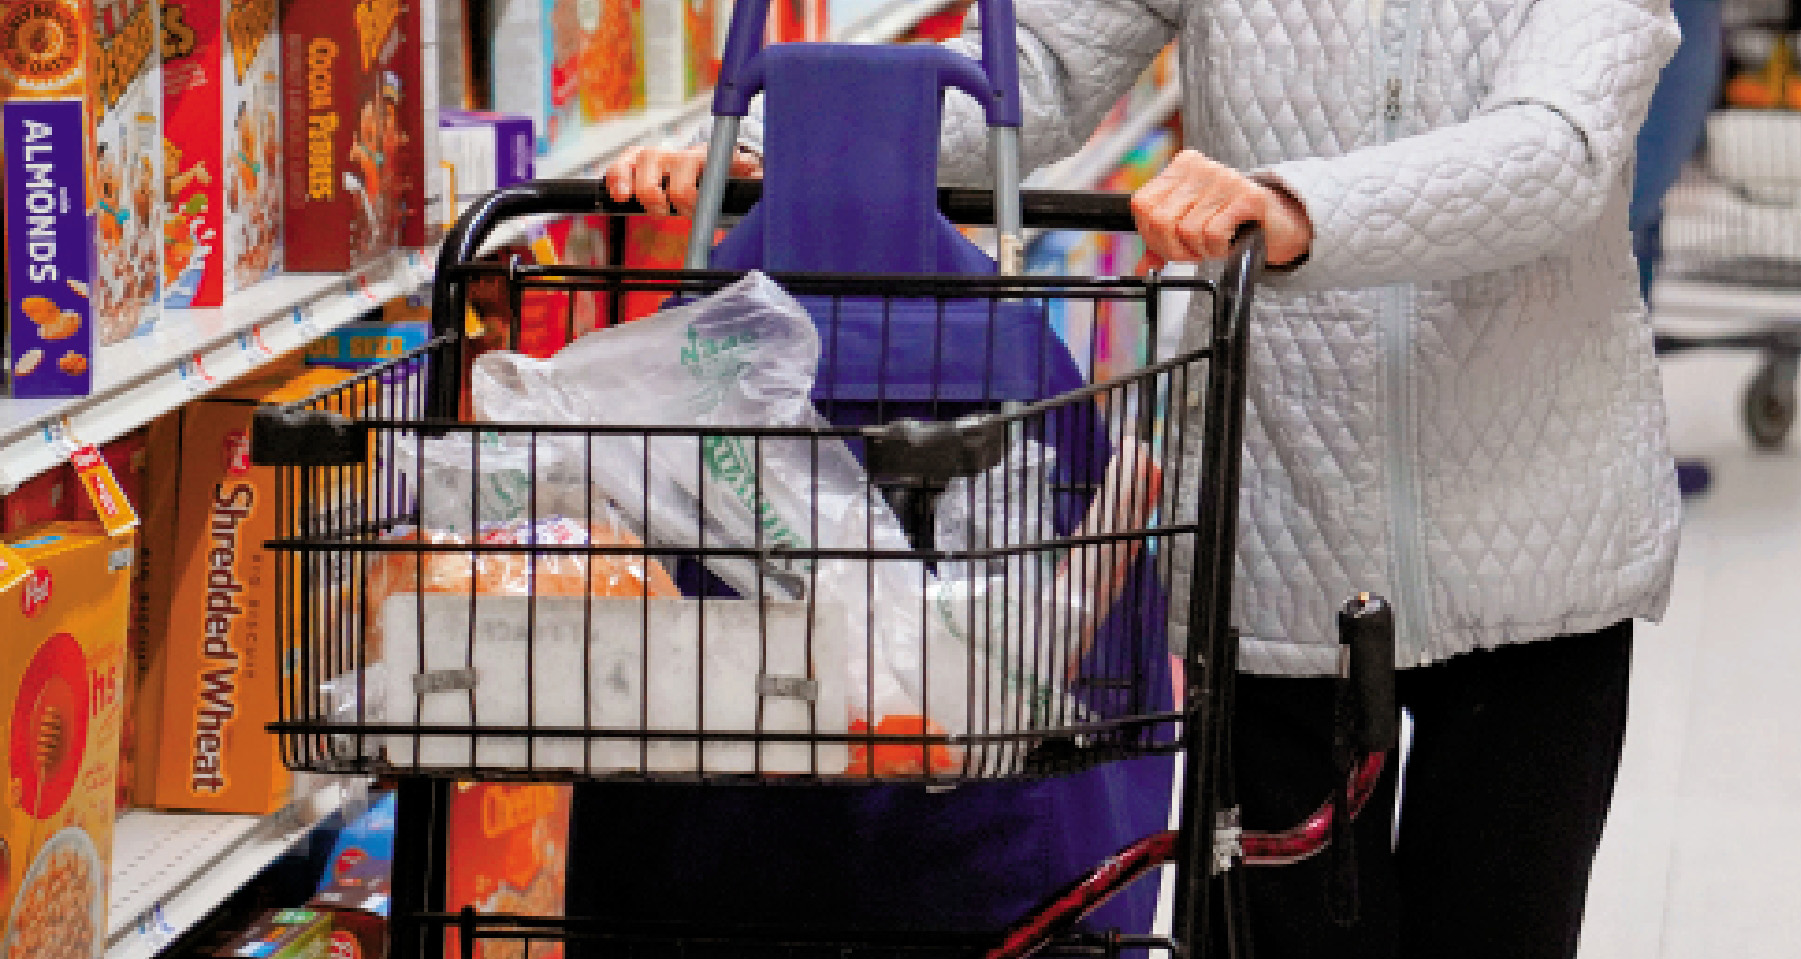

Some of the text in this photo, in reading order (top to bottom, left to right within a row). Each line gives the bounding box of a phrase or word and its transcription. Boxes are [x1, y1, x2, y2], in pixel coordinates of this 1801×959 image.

[22, 119, 57, 283] ALMONDS
[191, 482, 254, 794] Shredded Wheat
